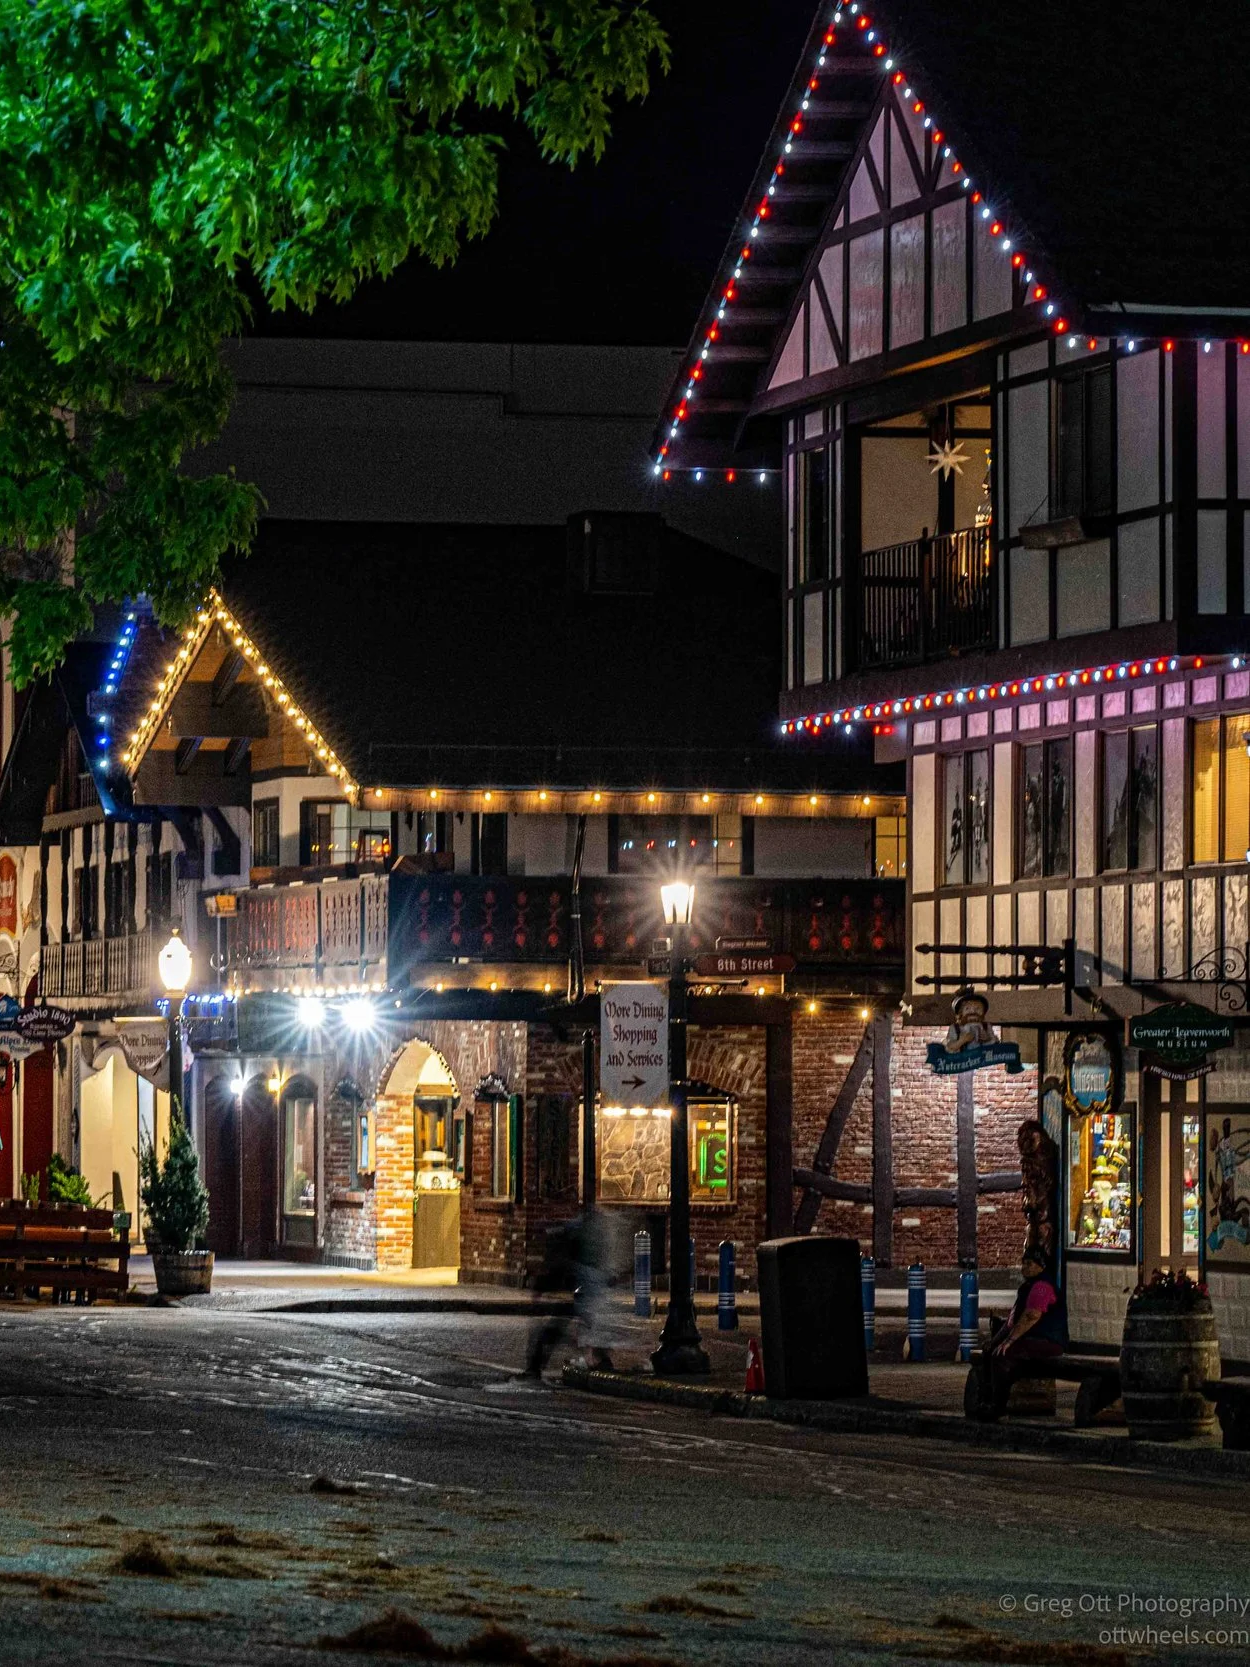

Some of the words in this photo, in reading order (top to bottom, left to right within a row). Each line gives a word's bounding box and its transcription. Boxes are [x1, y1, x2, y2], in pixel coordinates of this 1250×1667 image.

[740, 957, 774, 971] Street
[604, 1000, 631, 1018] More
[51, 1009, 71, 1025] 1890
[613, 1024, 657, 1046] Shopping
[1133, 1026, 1171, 1039] Greater
[1172, 1026, 1230, 1040] Leavenworth
[1156, 1040, 1208, 1048] MUSEUM
[606, 1051, 625, 1067] and
[627, 1049, 663, 1067] Services
[982, 1049, 1016, 1062] Museum
